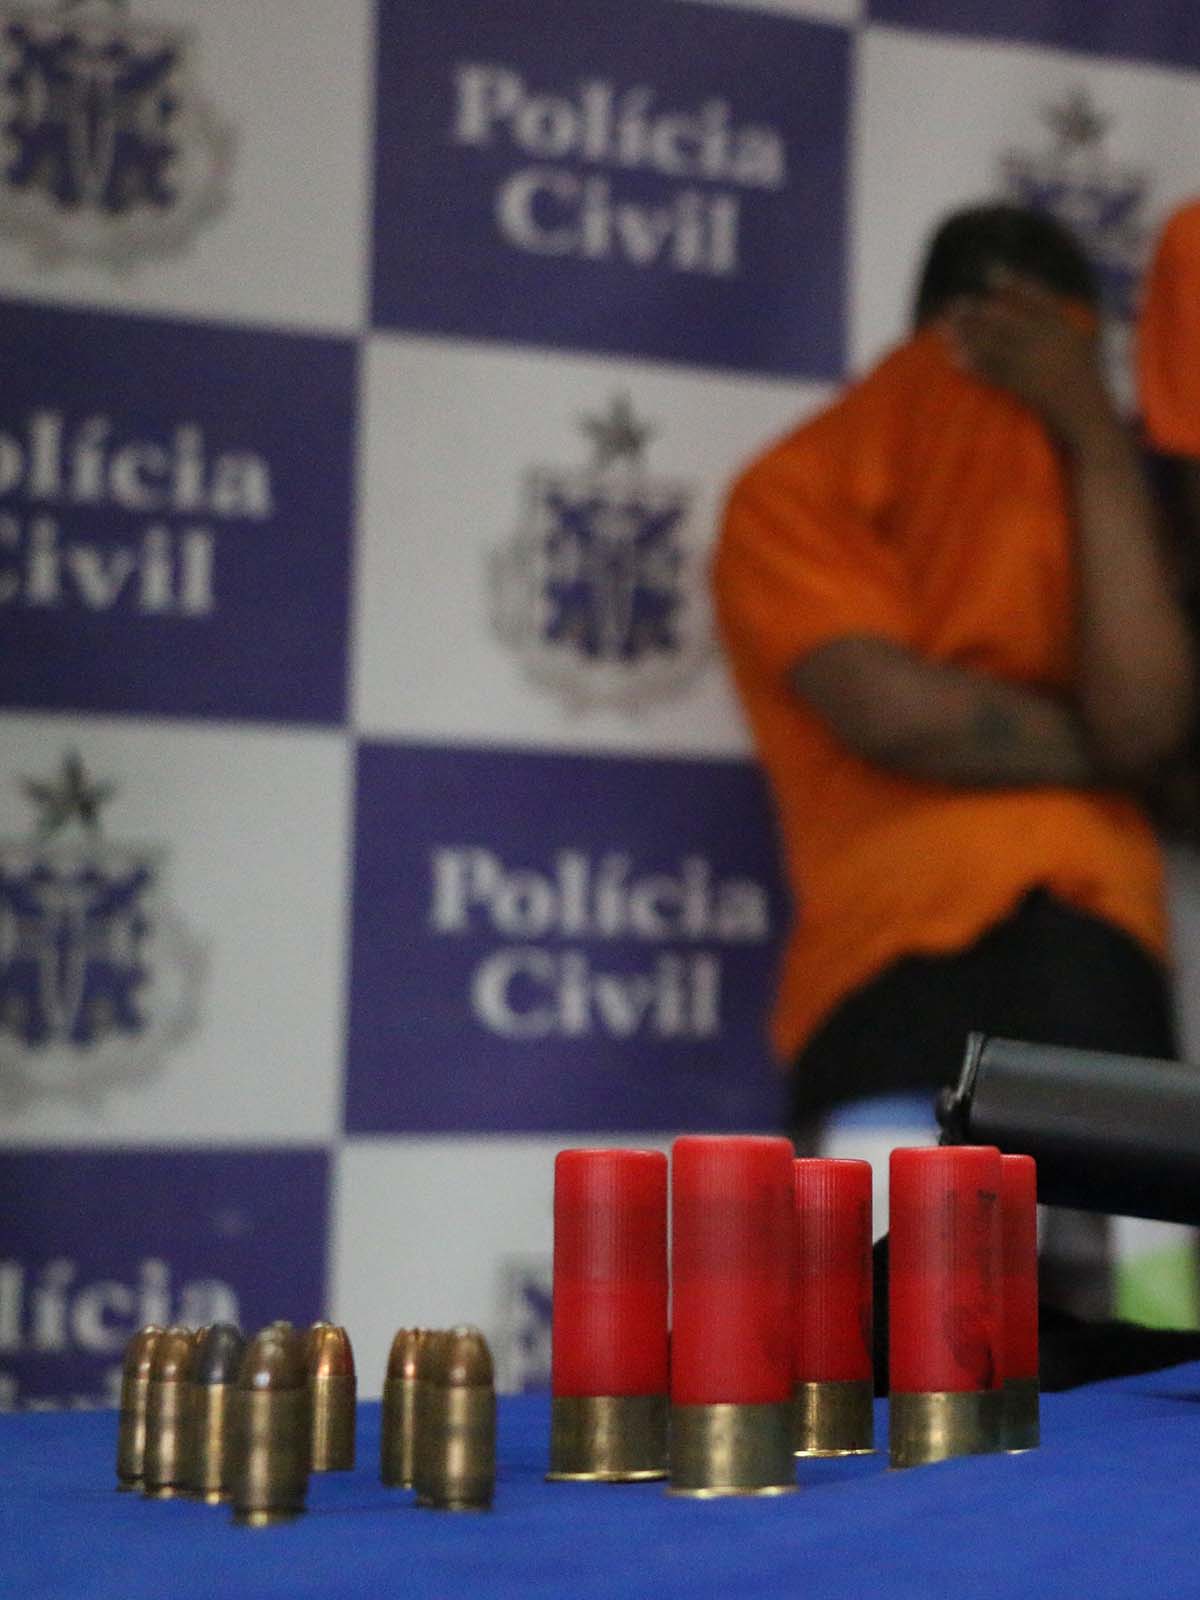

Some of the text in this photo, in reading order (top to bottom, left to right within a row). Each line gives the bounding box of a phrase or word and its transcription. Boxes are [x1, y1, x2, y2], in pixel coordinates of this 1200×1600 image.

[453, 64, 785, 188] Polícia
[495, 167, 739, 275] Civil
[427, 844, 765, 940] Polícia
[469, 945, 718, 1041] Civil
